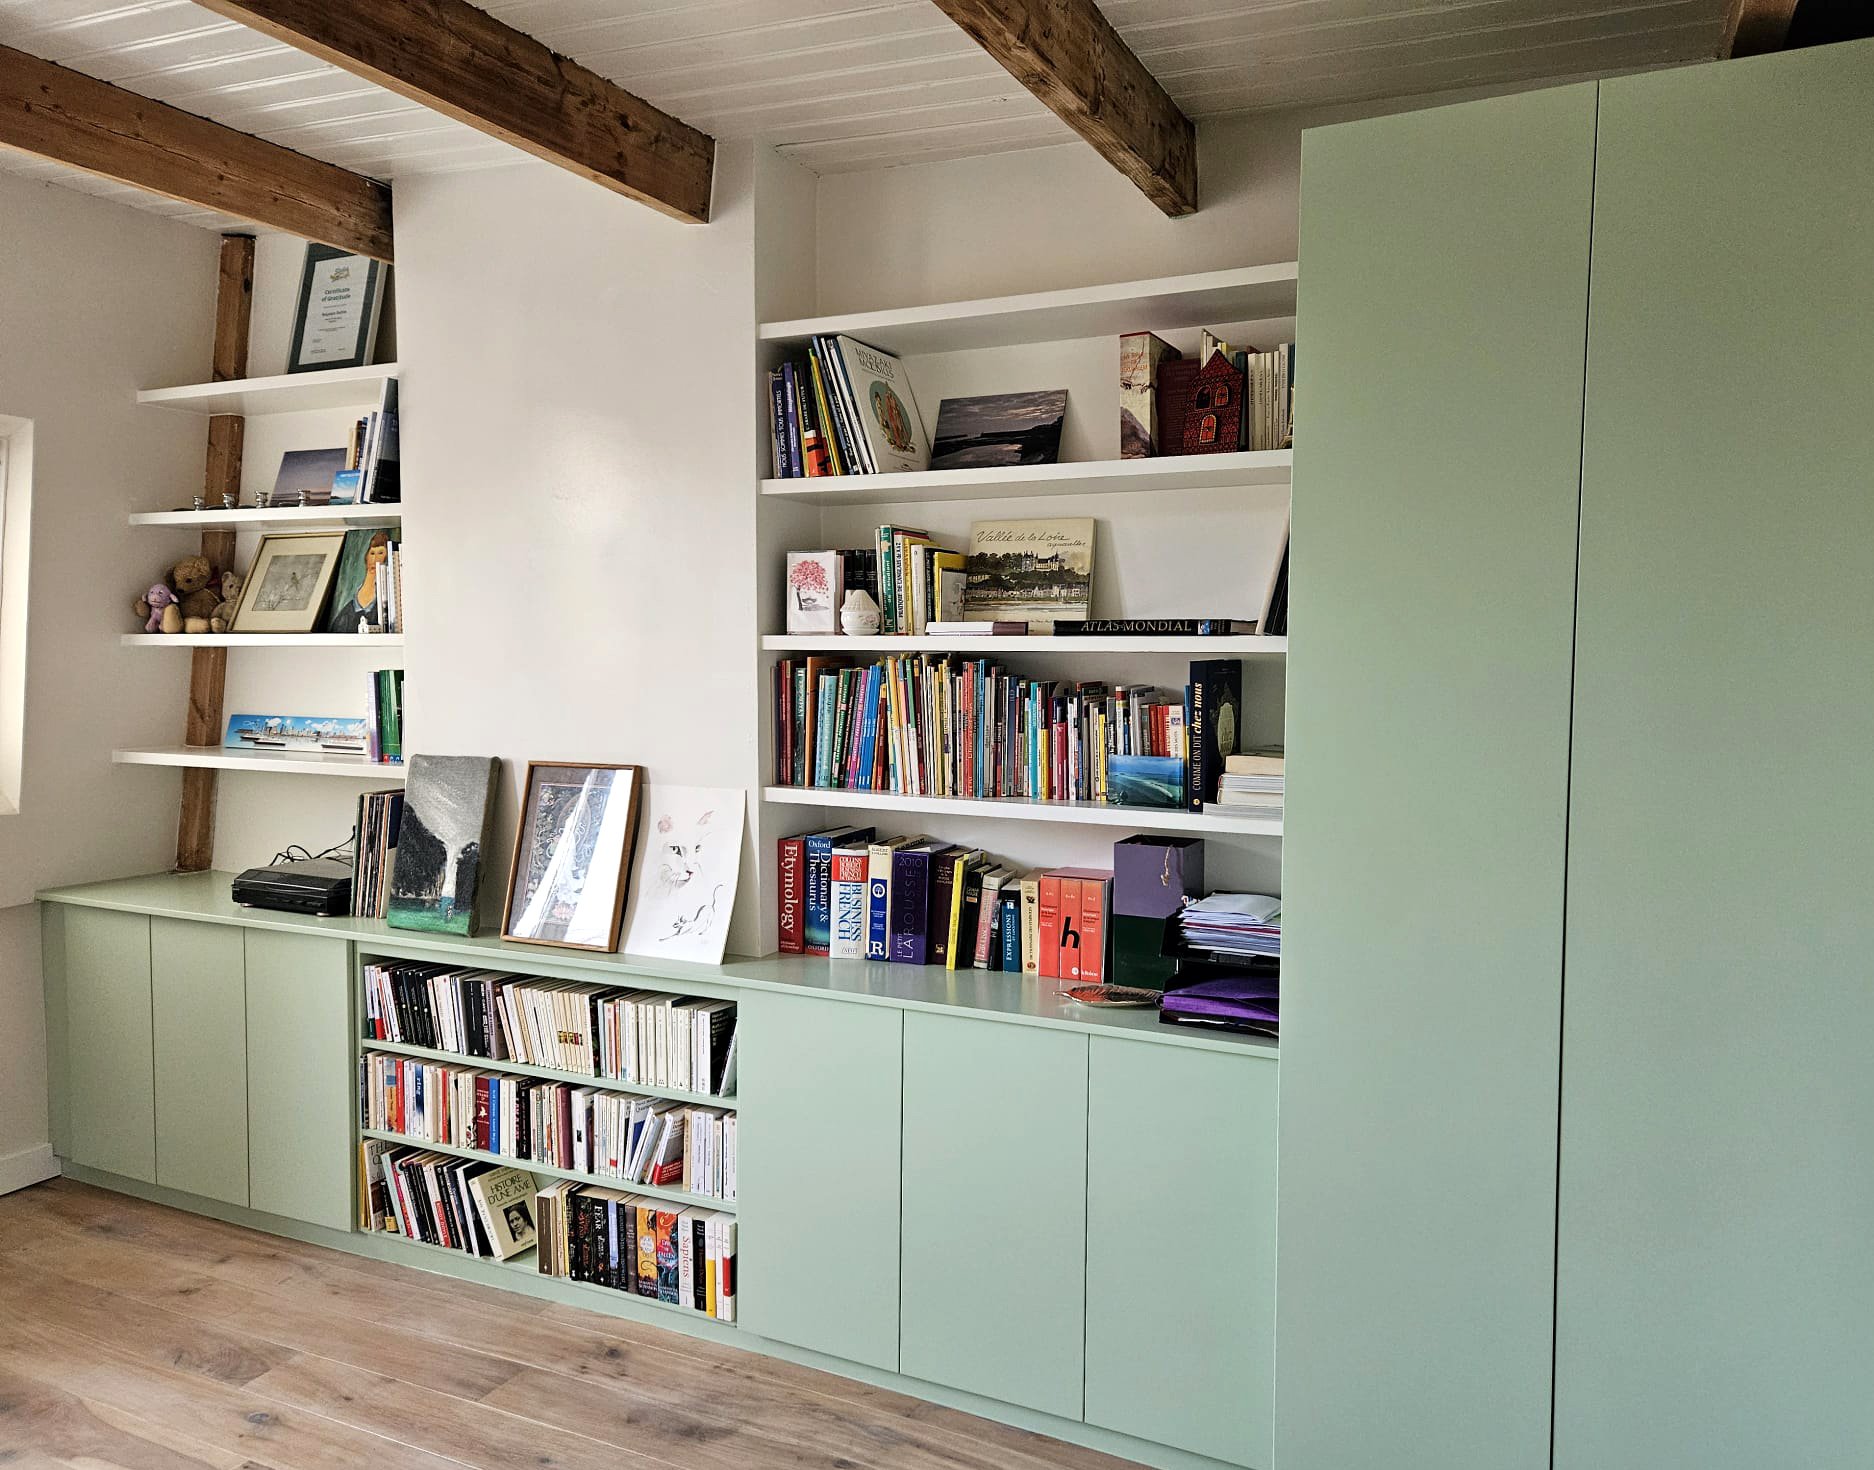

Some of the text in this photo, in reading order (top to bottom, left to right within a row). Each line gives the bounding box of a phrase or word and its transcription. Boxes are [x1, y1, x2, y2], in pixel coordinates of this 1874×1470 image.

[976, 529, 1070, 542] Vallée de la Loire
[1081, 620, 1120, 632] ATLAS
[1123, 620, 1192, 632] MONDIAL
[1192, 682, 1203, 790] COMME ON DIT chez nous
[808, 840, 831, 848] Oxford
[898, 857, 922, 868] 2010
[780, 844, 799, 934] Etymology
[809, 850, 820, 911] Thesaurus
[818, 852, 832, 922] Dictionary &
[838, 884, 850, 941] FRENCH
[850, 884, 862, 942] BUSINESS
[903, 870, 917, 959] LAROUSSE
[1061, 916, 1081, 948] h
[871, 941, 884, 956] R
[487, 1188, 513, 1205] D'UNE
[490, 1174, 524, 1194] HISTOIRE
[594, 1205, 603, 1230] FEAR
[680, 1236, 692, 1279] Sapiens
